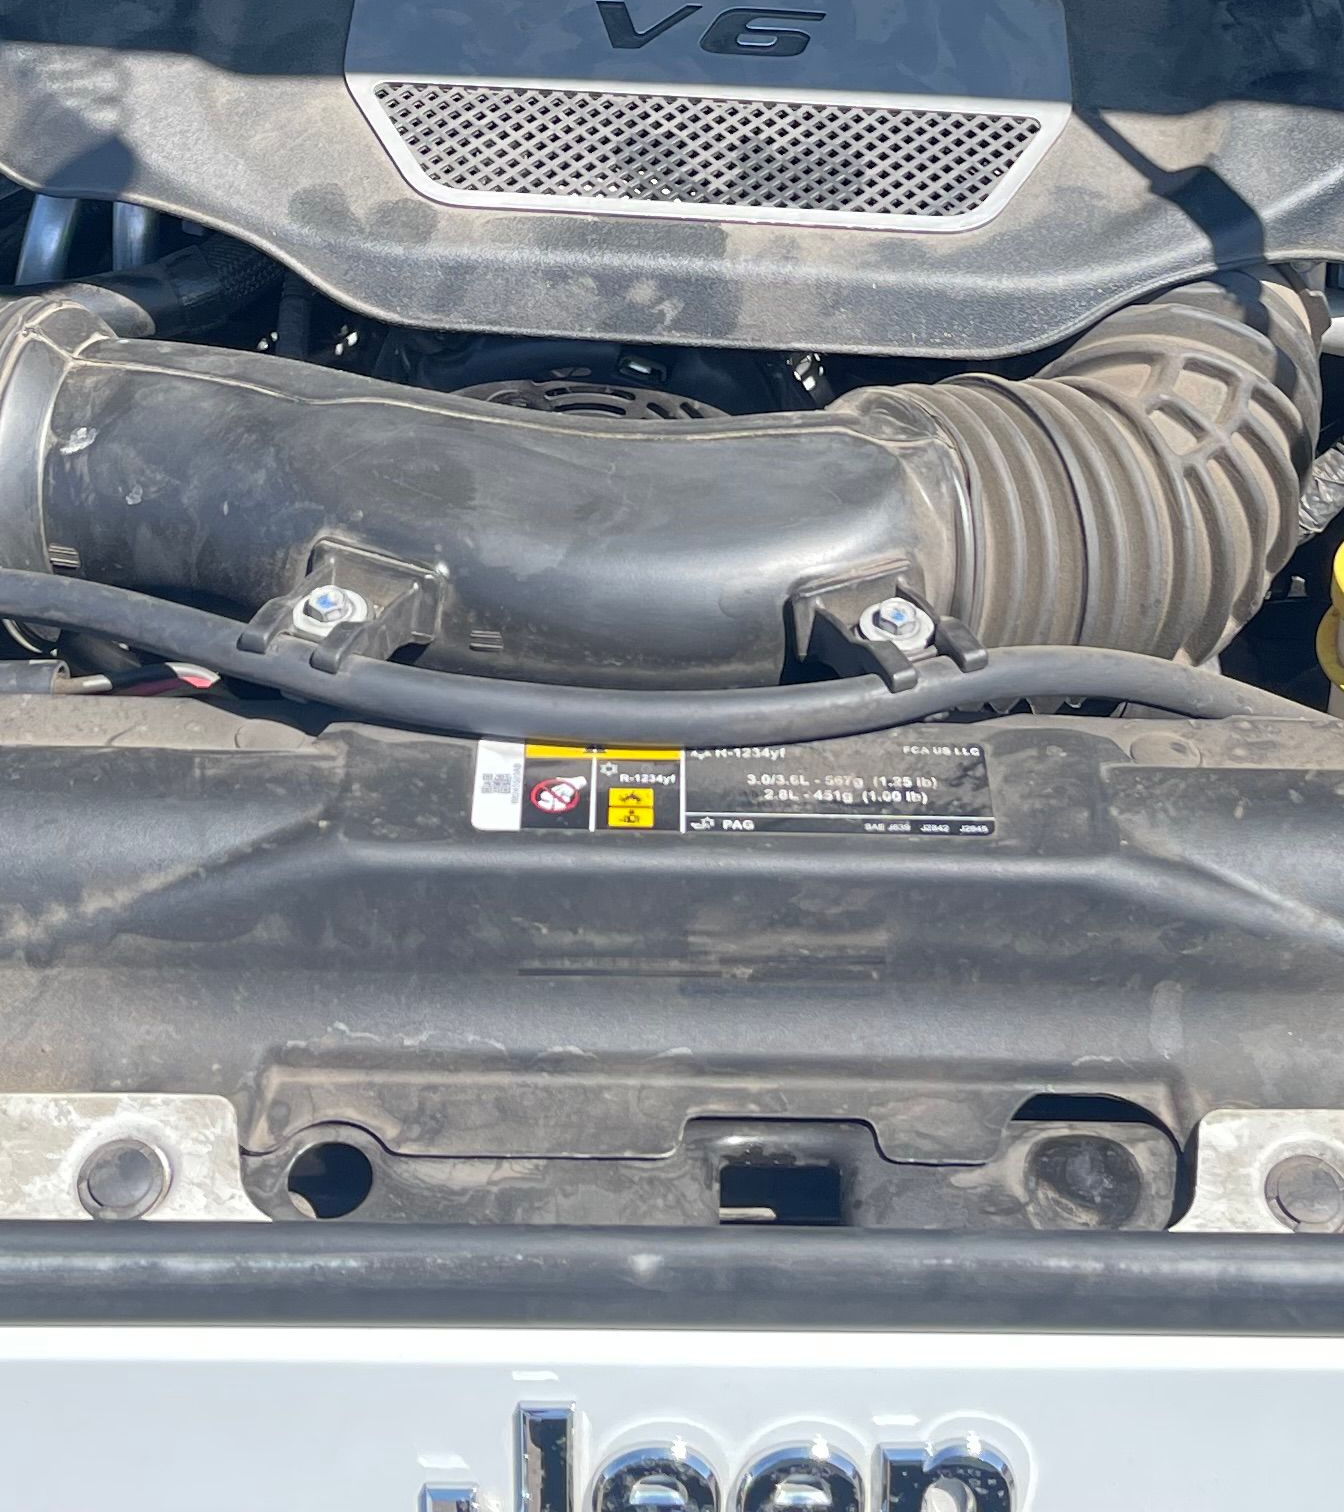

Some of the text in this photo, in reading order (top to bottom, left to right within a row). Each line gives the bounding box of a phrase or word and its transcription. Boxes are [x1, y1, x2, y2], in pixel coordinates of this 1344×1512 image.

[594, 0, 827, 58] V6
[902, 744, 980, 757] FCA US LLC
[619, 773, 677, 786] R-1234yf
[747, 772, 809, 787] 3.0/3.6L
[824, 774, 864, 789] 567g
[872, 774, 913, 789] (1.25
[916, 774, 938, 790] lb)
[763, 788, 797, 802] 2.8L
[862, 790, 904, 805] (1.00
[906, 790, 929, 806] lb)
[722, 818, 755, 832] PAG
